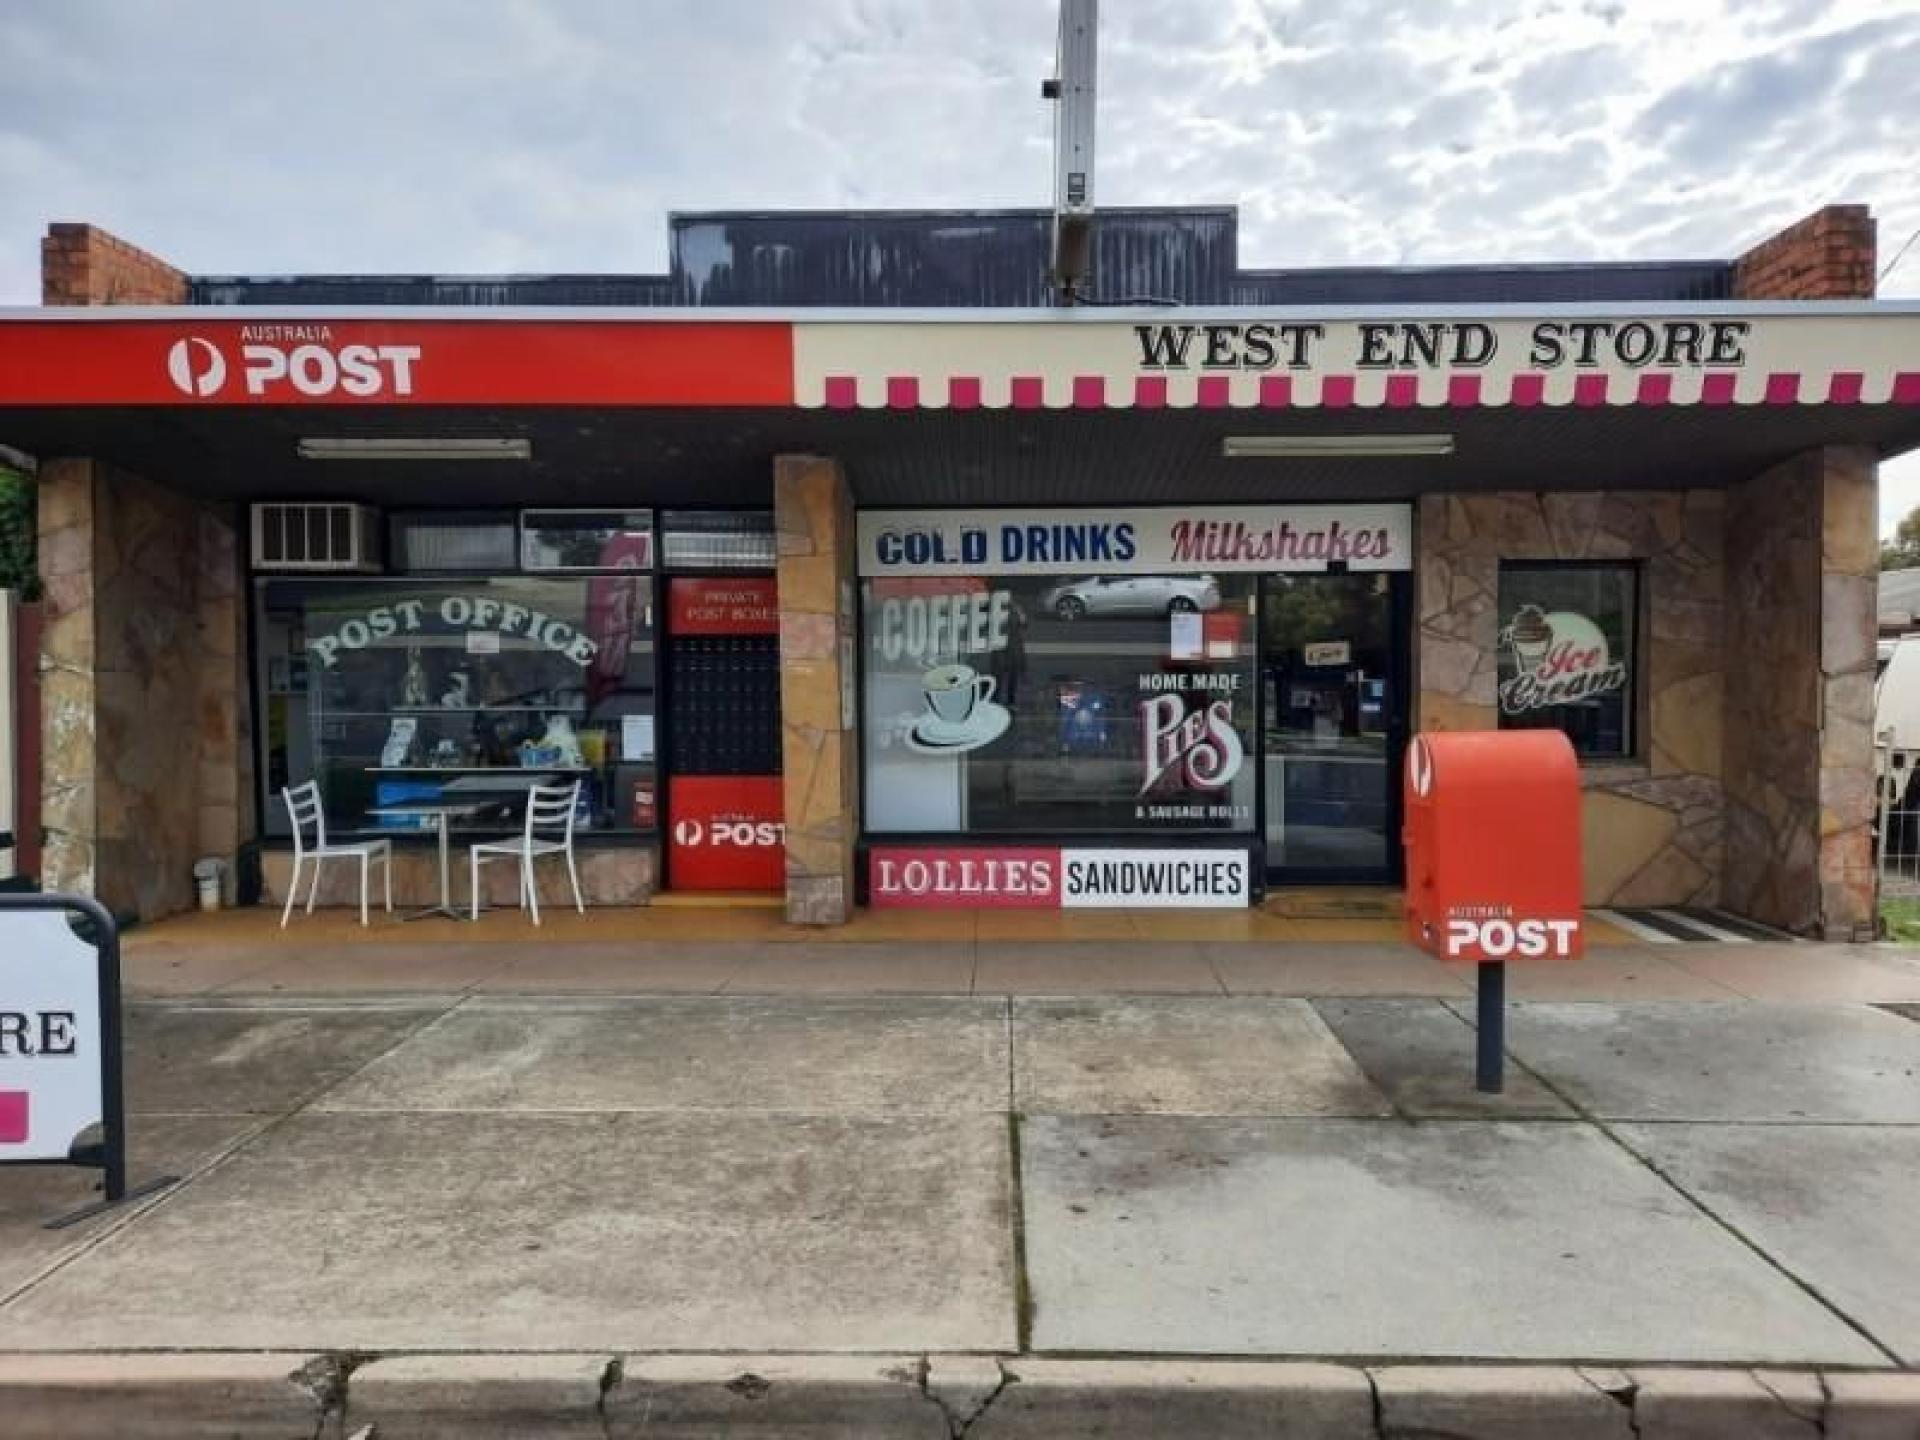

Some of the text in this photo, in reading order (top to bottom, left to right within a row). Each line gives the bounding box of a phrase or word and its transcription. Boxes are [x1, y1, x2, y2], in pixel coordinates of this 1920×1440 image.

[241, 325, 332, 341] AUSTRALIA
[1134, 321, 1751, 369] WEST END STORE
[243, 345, 421, 396] POST
[876, 523, 1137, 565] COLD DRINKS
[1170, 520, 1393, 563] Milkshakes
[307, 600, 423, 668] POST
[440, 597, 599, 667] OFFICE
[881, 590, 1011, 661] COFFEE
[1537, 639, 1602, 679] Ice
[1139, 673, 1242, 690] HOME MADE
[1501, 664, 1625, 713] Cream
[878, 859, 1052, 893] LOLLIES
[1067, 861, 1242, 895] SANDWICHES
[1448, 919, 1577, 956] POST
